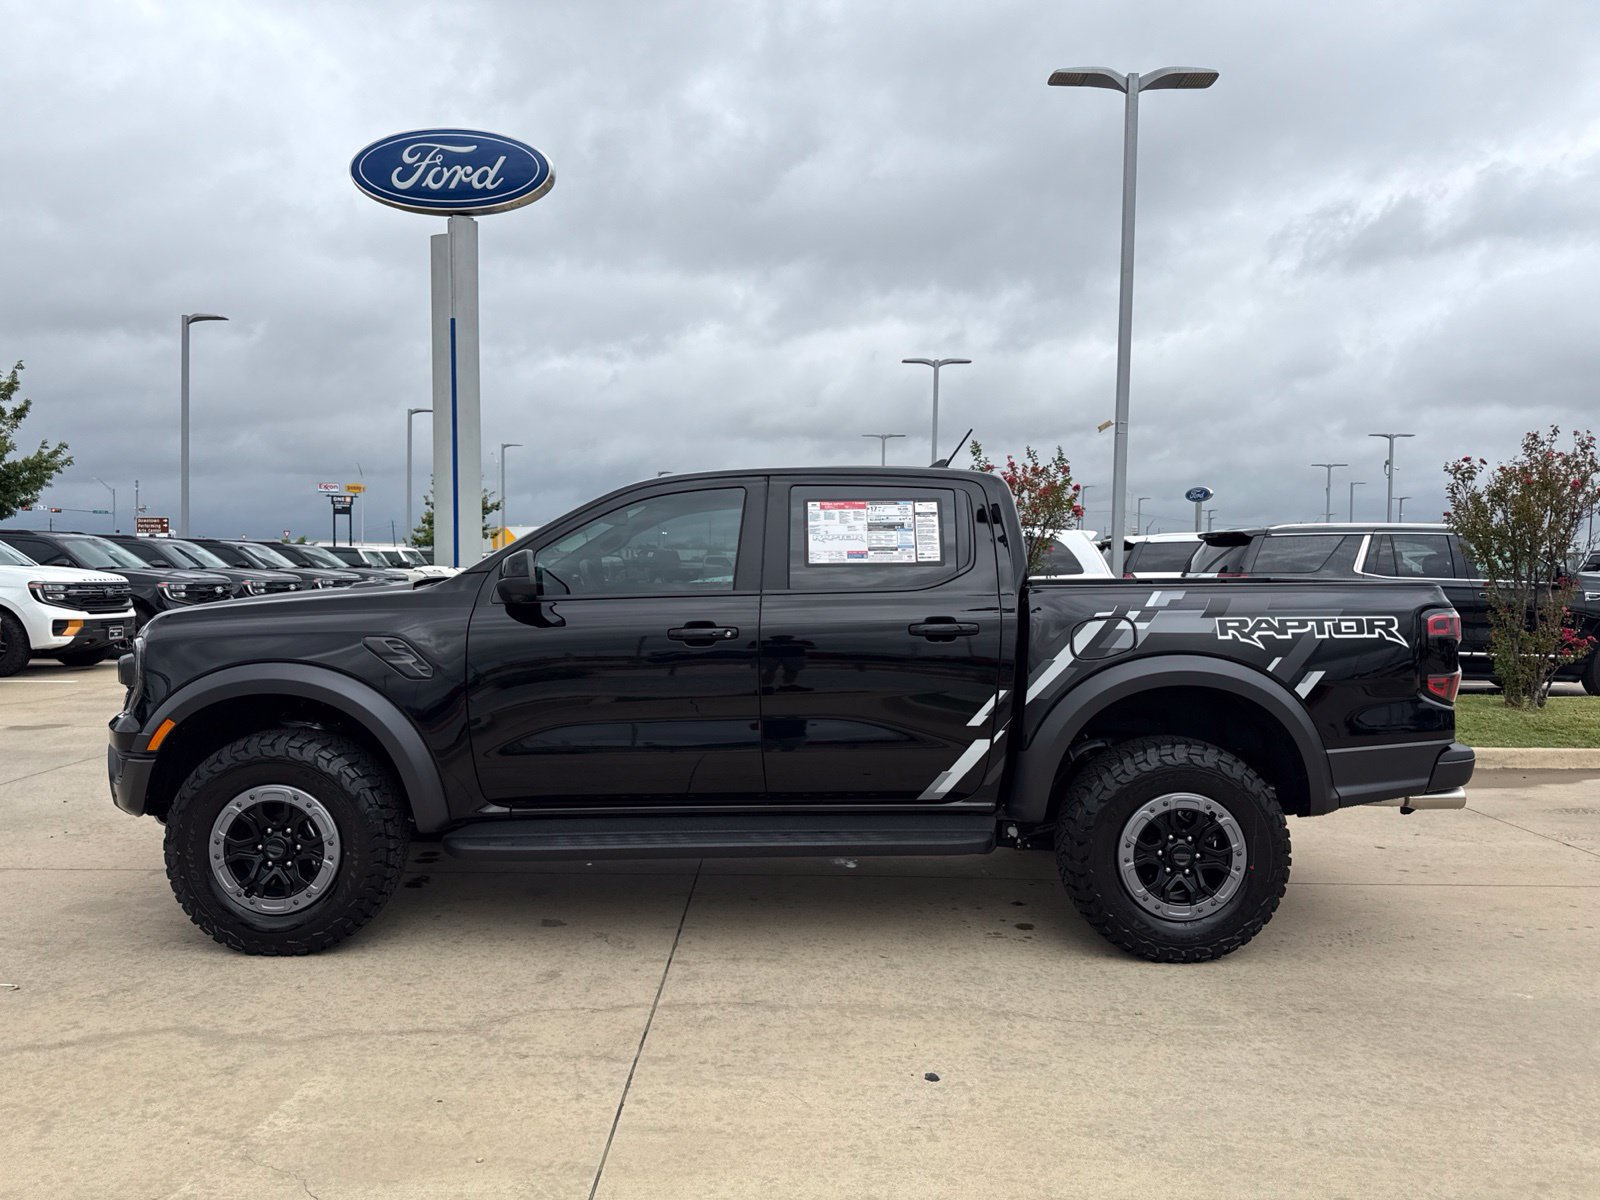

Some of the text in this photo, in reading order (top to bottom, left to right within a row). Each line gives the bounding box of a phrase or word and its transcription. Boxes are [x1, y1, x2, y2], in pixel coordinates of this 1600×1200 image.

[391, 143, 507, 190] Ford
[319, 483, 338, 491] Exxon
[1190, 489, 1205, 499] Ford
[1215, 615, 1410, 650] RAPTOR
